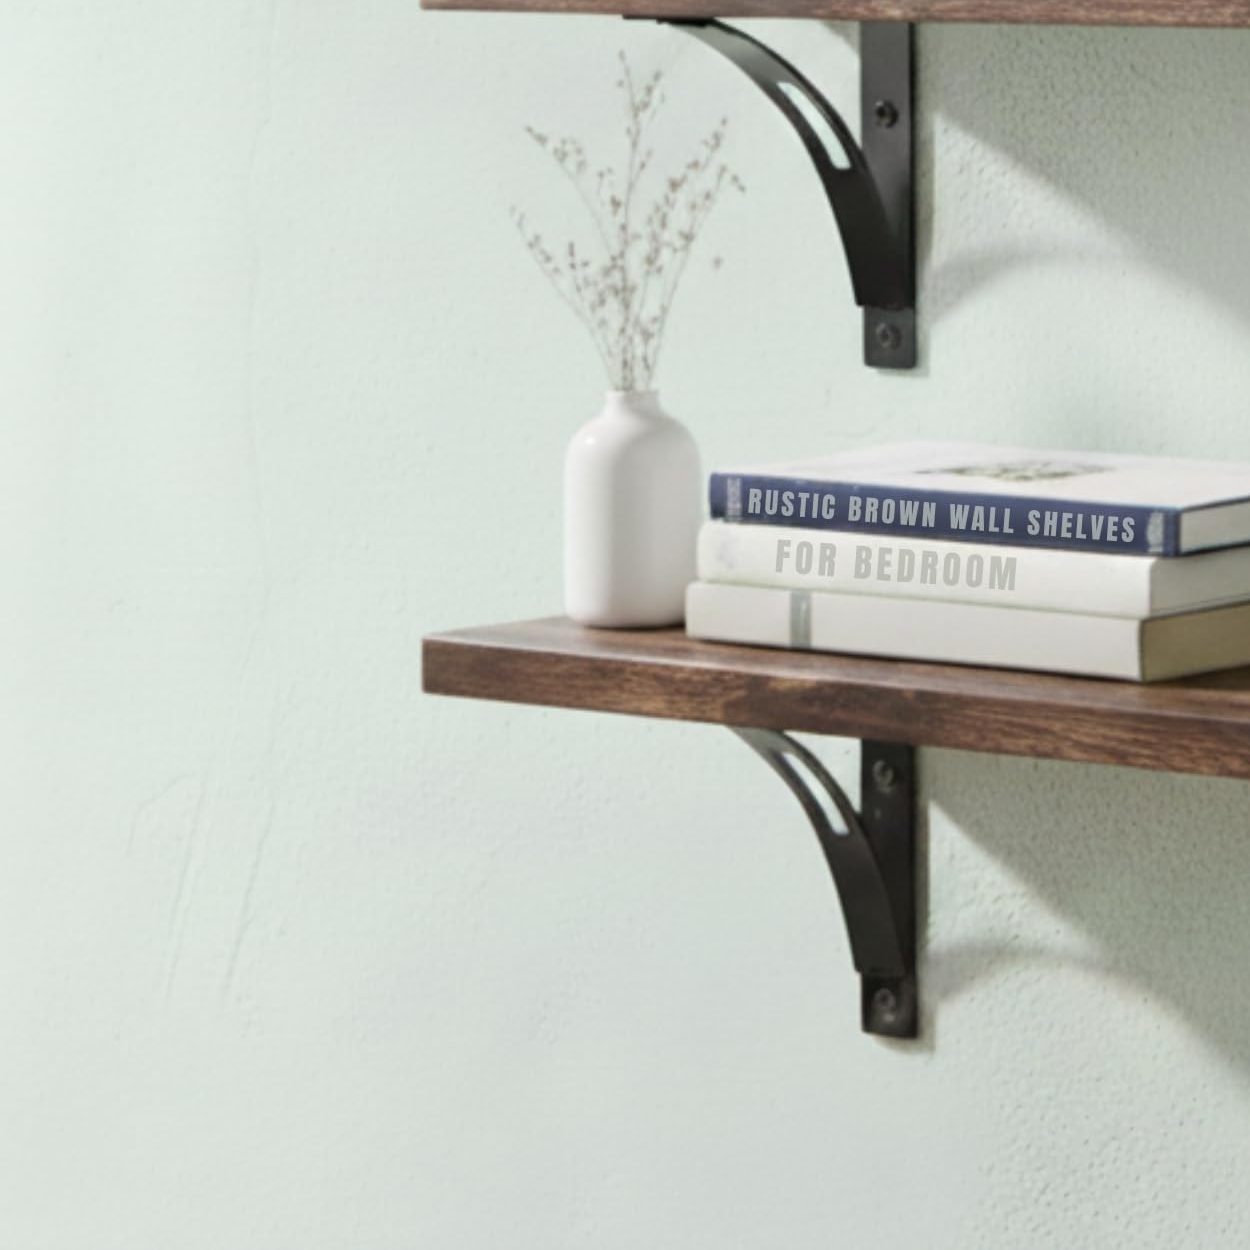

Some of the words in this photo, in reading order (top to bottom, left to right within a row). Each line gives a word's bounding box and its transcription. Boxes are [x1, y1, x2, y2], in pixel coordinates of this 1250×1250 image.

[748, 488, 836, 520] RUSTIC
[848, 496, 936, 528] BROWN
[949, 503, 1014, 534] WALL
[1027, 509, 1136, 543] SHELVES
[775, 539, 837, 577] FOR
[854, 545, 1018, 591] BEDROOM
